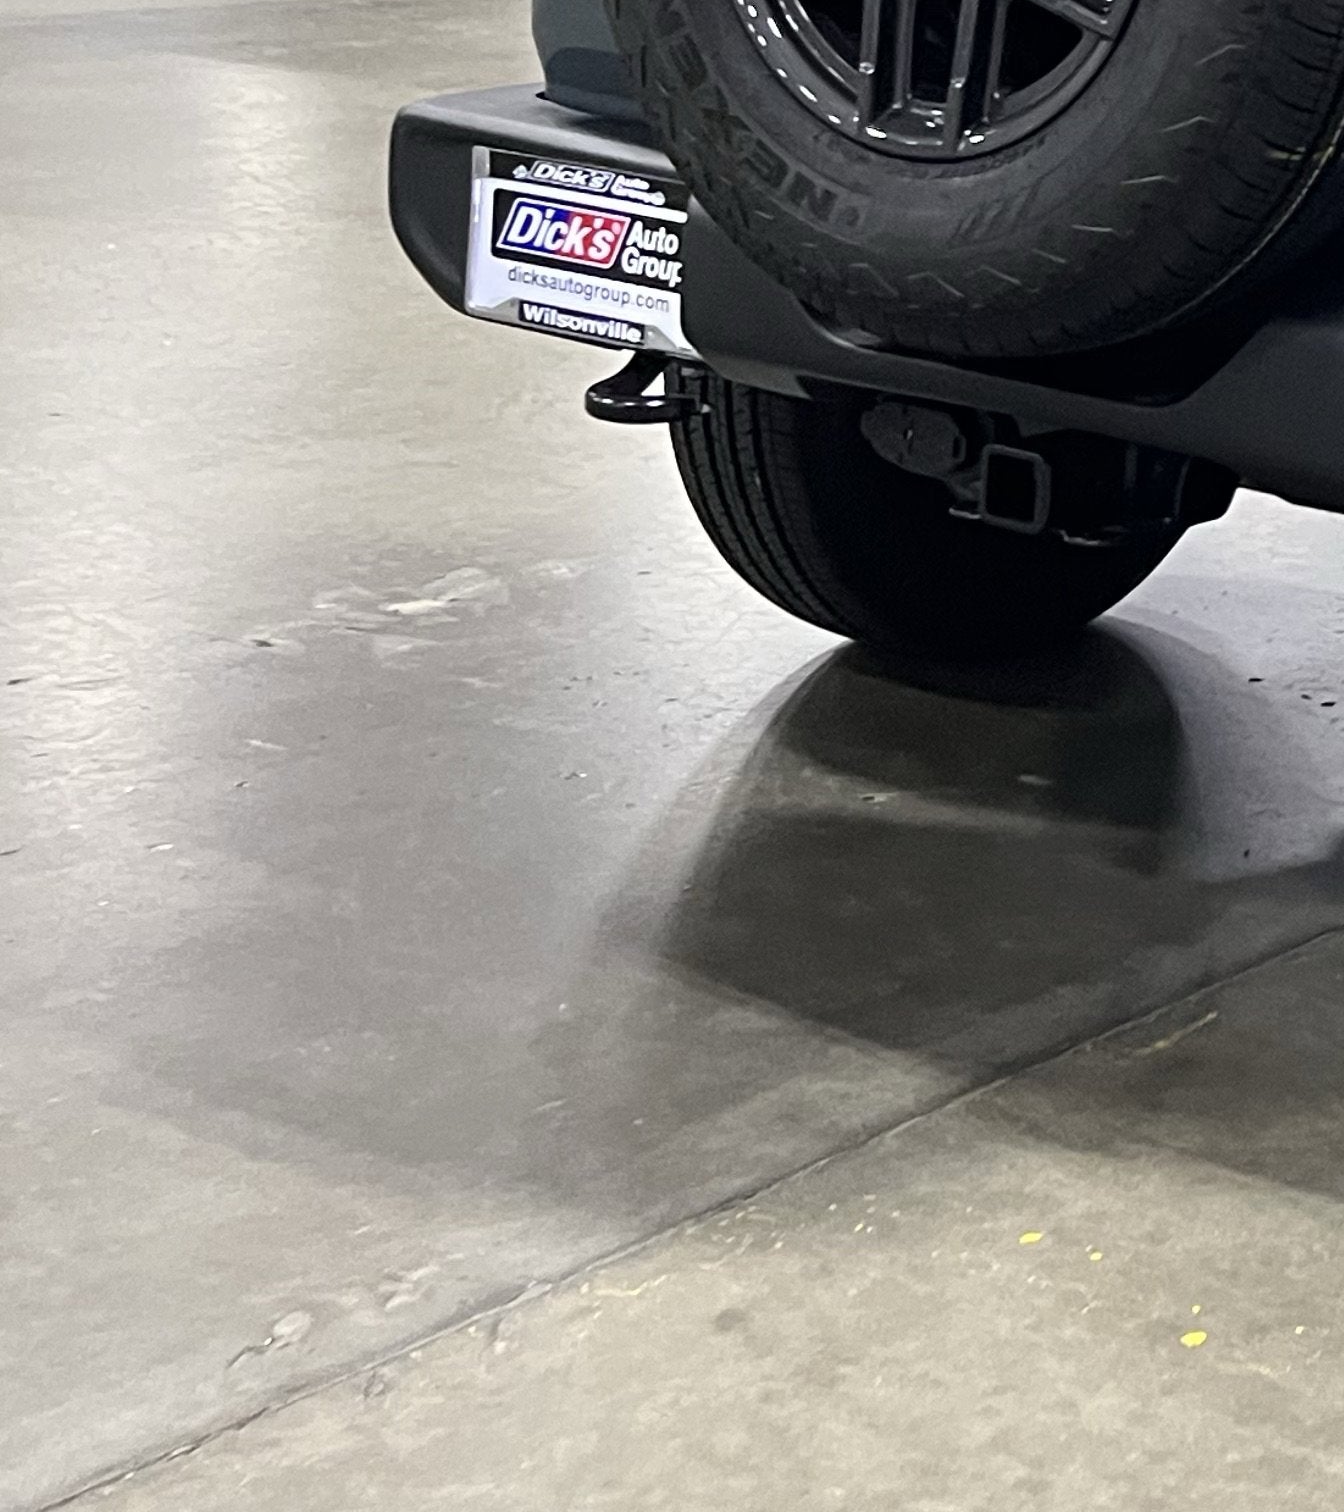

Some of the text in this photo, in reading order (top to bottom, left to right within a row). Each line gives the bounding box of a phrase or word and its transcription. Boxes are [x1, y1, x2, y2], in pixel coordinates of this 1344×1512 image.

[506, 205, 615, 260] Dick's
[626, 220, 679, 255] Auto
[508, 266, 670, 313] dicksautogroup.com
[523, 303, 643, 343] Wilsonville
